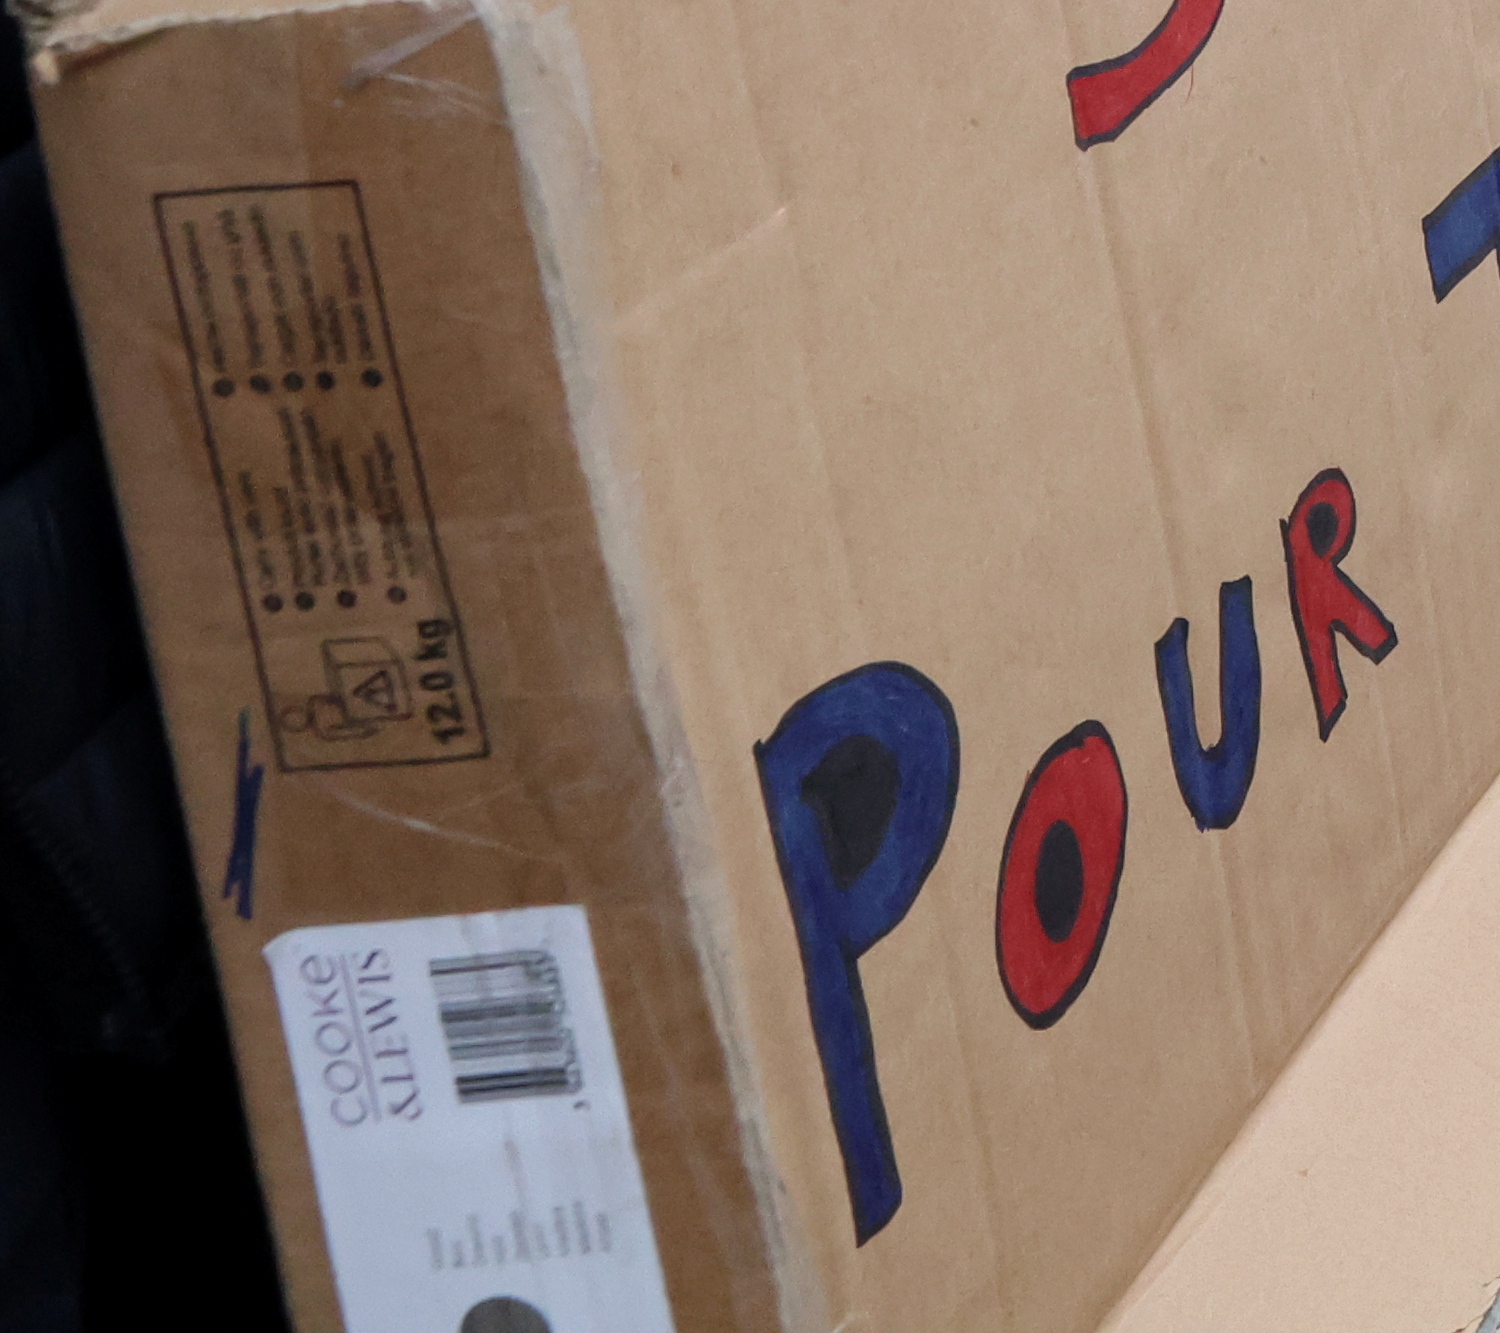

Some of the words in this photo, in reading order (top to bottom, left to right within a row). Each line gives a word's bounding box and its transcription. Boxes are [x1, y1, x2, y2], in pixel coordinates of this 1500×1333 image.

[413, 620, 454, 661] kg
[418, 669, 466, 745] 12.0
[753, 467, 1398, 1247] POUR
